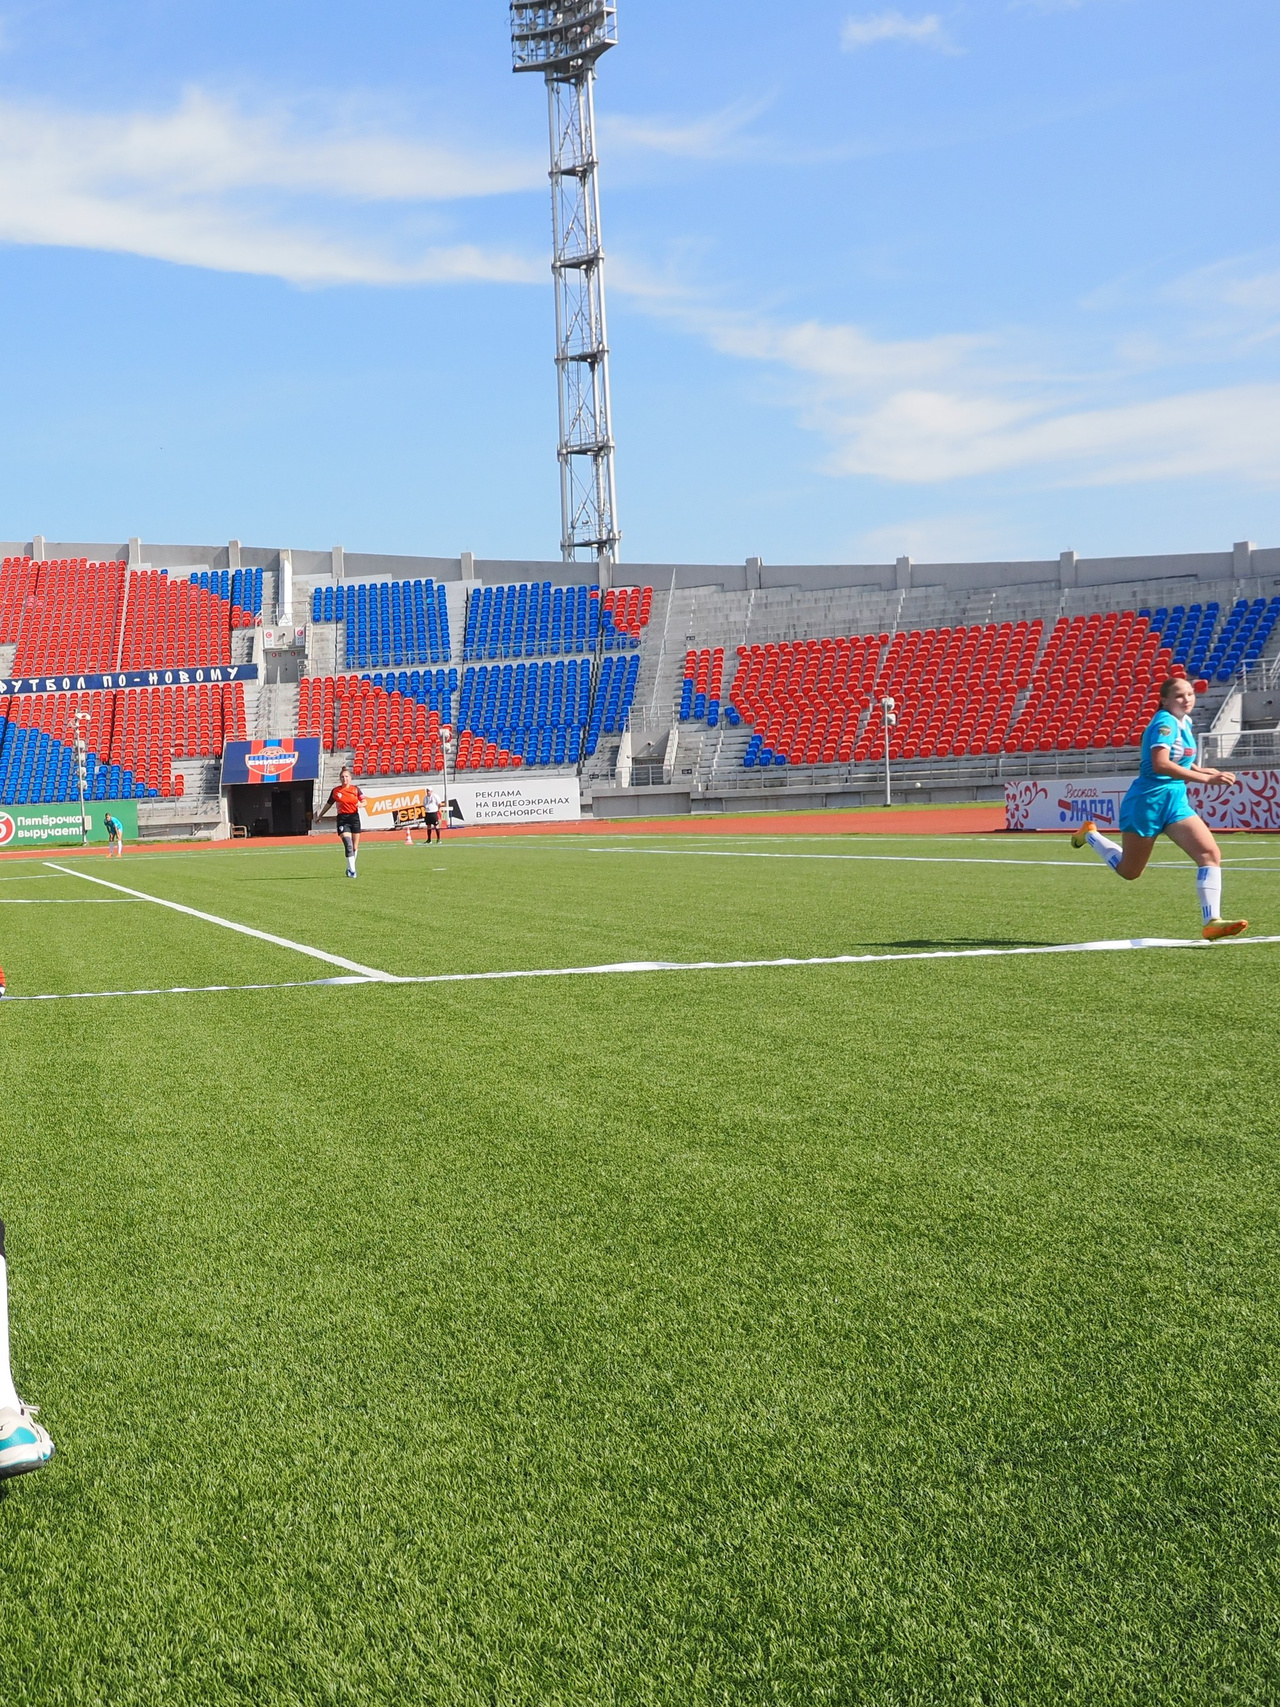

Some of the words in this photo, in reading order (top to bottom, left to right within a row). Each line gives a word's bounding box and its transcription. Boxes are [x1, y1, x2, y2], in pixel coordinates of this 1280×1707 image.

[102, 667, 239, 687] ПО-НОВОМУ
[475, 789, 522, 799] РЕКЛАМА
[372, 794, 420, 813] МЕДИА
[475, 800, 489, 809] НА
[491, 797, 570, 809] ВИДЕОЭКРАНАХ
[475, 810, 482, 818] В
[484, 808, 555, 818] КРАСНОЯРСКЕ
[1069, 798, 1115, 822] ЛАПТА
[17, 814, 82, 827] Пятёрочка
[17, 827, 83, 839] выручает!
